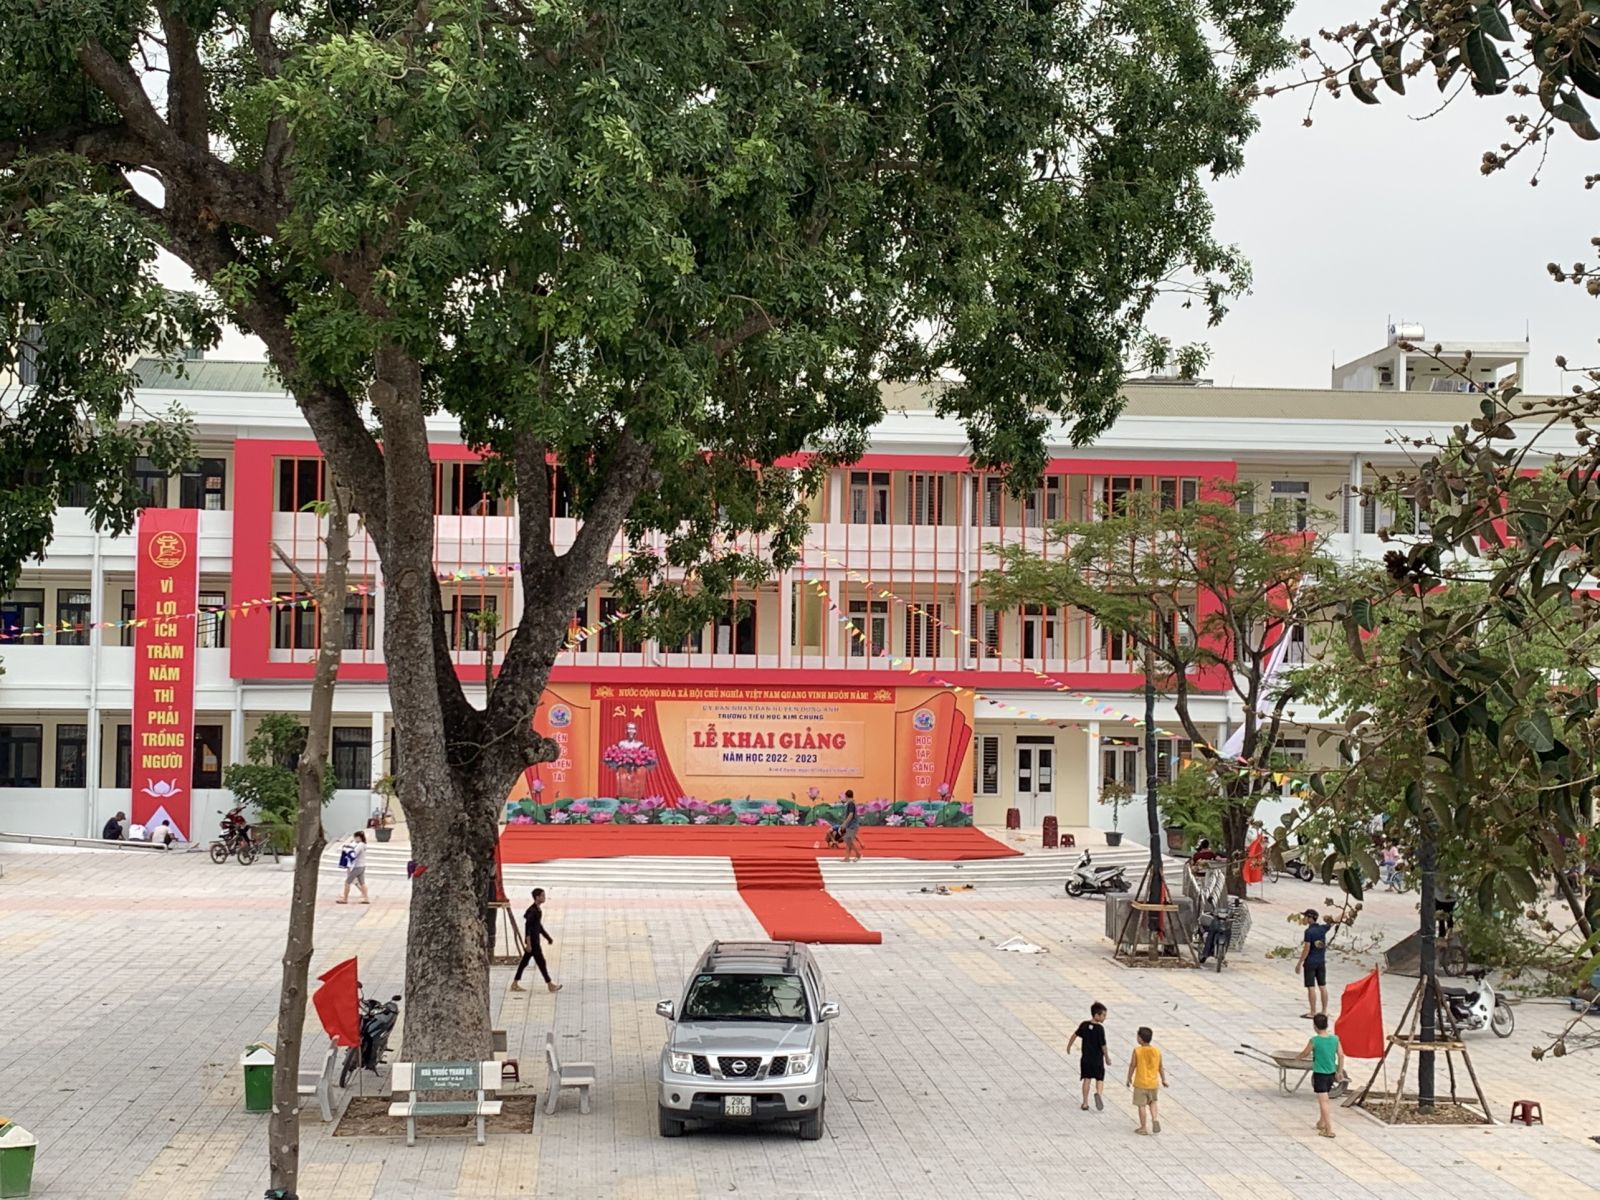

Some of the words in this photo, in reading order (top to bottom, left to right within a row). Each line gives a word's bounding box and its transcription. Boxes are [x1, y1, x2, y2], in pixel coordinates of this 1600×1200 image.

[160, 576, 173, 593] VÌ
[156, 600, 177, 618] LỢI
[146, 642, 184, 659] TRĂM
[149, 664, 180, 681] NĂM
[153, 686, 175, 703] THÌ
[619, 687, 639, 697] NƯỚC
[640, 687, 660, 698] CỘNG
[689, 688, 703, 699] HỘI
[704, 687, 719, 698] CHỦ
[720, 688, 744, 698] NGHĨA
[745, 688, 763, 700] VIỆT
[763, 690, 780, 699] NAM
[781, 690, 807, 700] QUANG
[807, 690, 828, 700] VINH
[828, 689, 849, 700] MUÔN
[148, 705, 179, 725] PHẢI
[693, 723, 718, 748] LỄ
[722, 731, 775, 749] KHAI
[779, 726, 846, 750] GIẢNG
[142, 751, 183, 769] NGƯỜI
[722, 751, 743, 762] NĂM
[745, 753, 763, 764] HỌC
[766, 753, 788, 763] 2022
[795, 754, 817, 763] 2023
[731, 1096, 746, 1106] 29C
